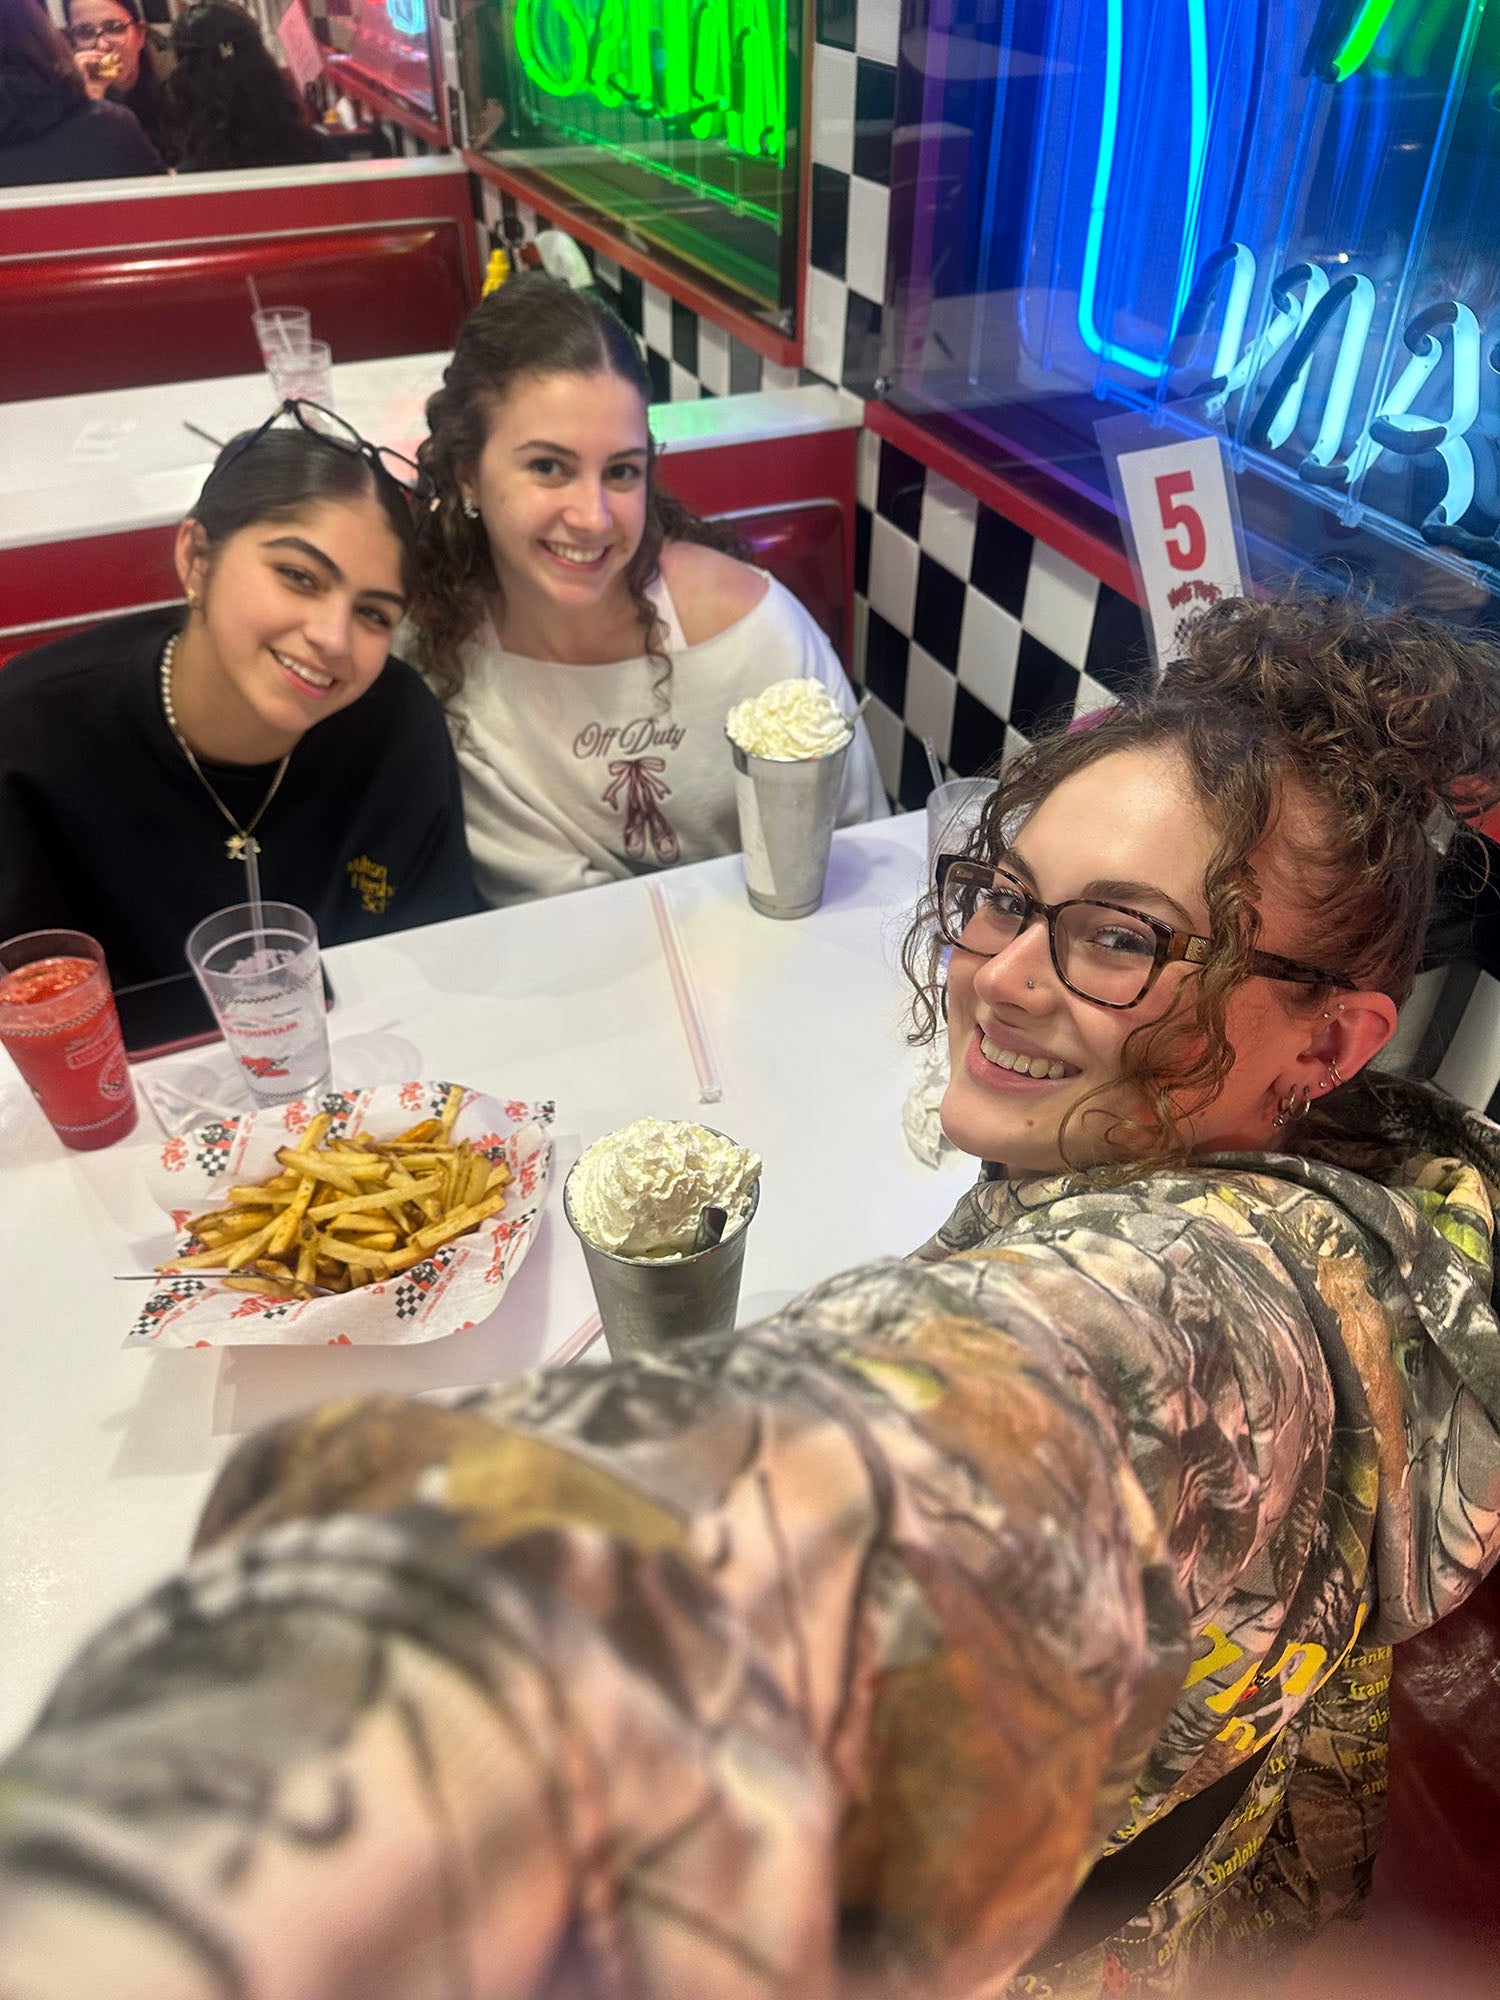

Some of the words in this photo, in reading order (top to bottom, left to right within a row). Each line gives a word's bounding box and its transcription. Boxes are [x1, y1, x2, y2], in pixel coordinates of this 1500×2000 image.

[1155, 470, 1207, 571] 5
[573, 721, 620, 760] Off
[619, 717, 687, 755] Duty
